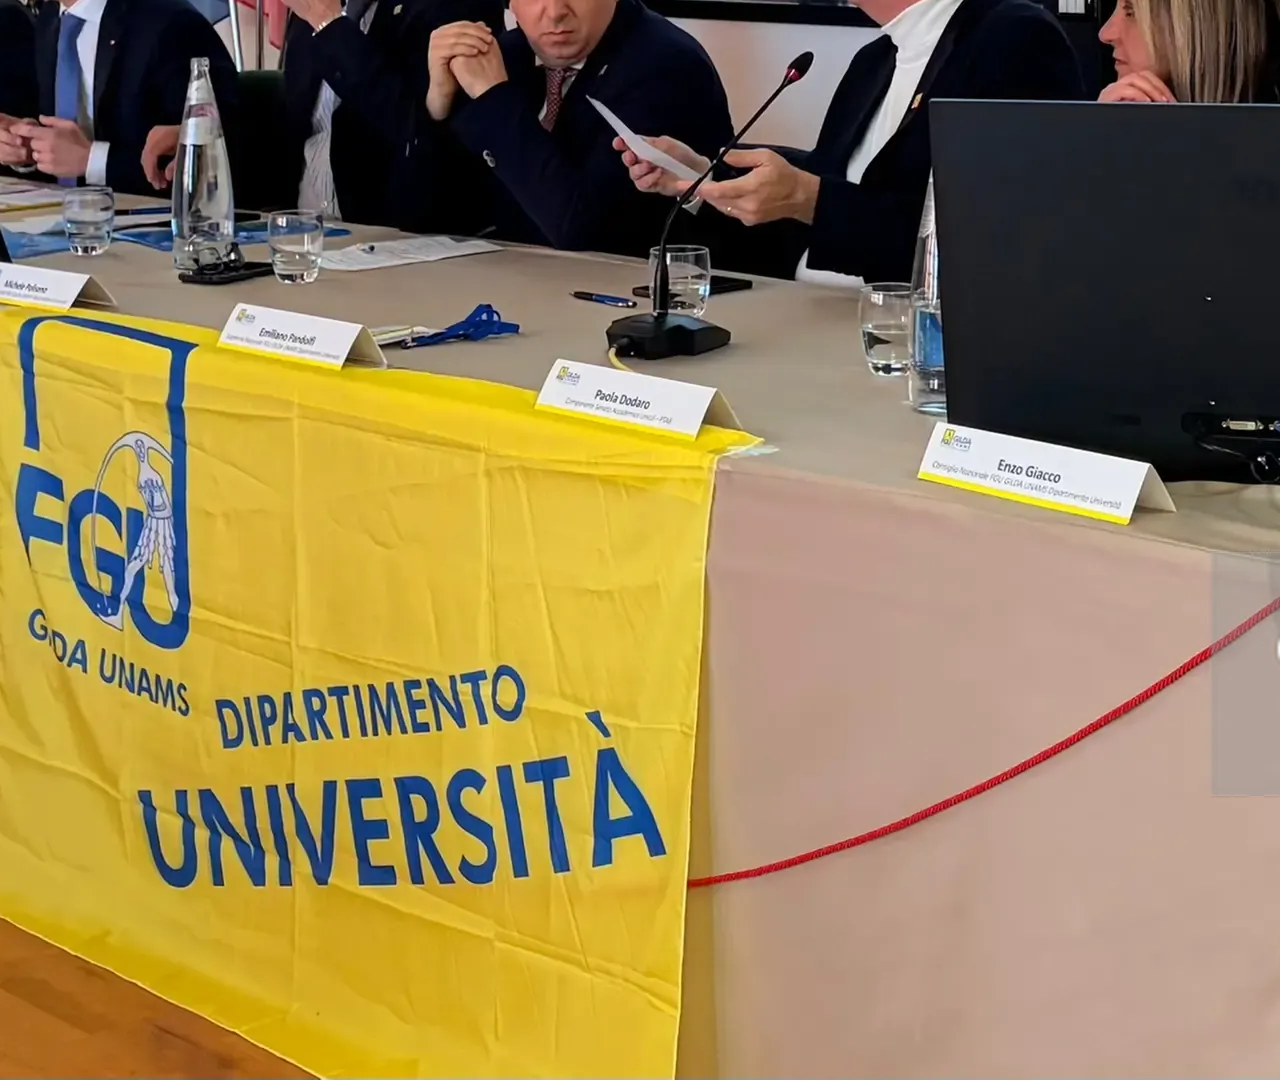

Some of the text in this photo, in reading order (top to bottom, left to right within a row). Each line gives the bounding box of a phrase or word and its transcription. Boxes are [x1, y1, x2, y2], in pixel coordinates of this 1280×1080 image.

[259, 328, 316, 346] Emiliano Pandolfi
[595, 389, 650, 409] Paola Dodaro
[932, 461, 958, 473] Consiglio
[1004, 477, 1023, 488] GILDA
[1048, 487, 1089, 503] Dipartimento
[997, 459, 1061, 483] Enzo Giacco
[16, 463, 191, 649] FGU
[99, 648, 190, 717] UNAMS
[215, 664, 527, 749] DIPARTIMENTO
[137, 710, 667, 888] UNIVERSITÀ
